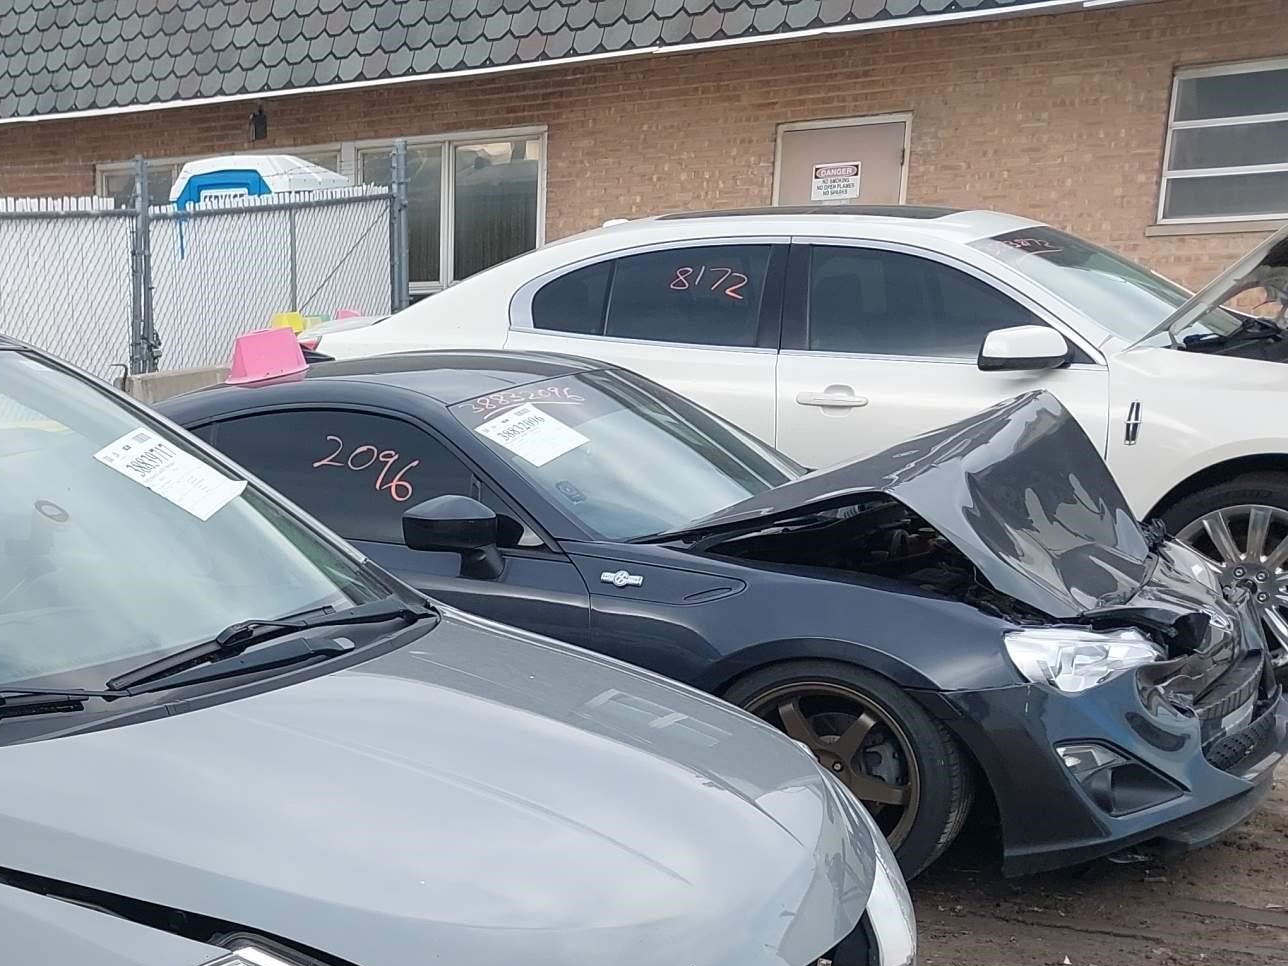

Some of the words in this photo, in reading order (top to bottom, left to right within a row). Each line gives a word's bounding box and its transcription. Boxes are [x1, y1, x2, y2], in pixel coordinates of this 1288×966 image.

[820, 168, 852, 176] DANGER
[670, 266, 748, 300] 8172
[125, 442, 177, 478] 38839717
[312, 435, 420, 502] 2096
